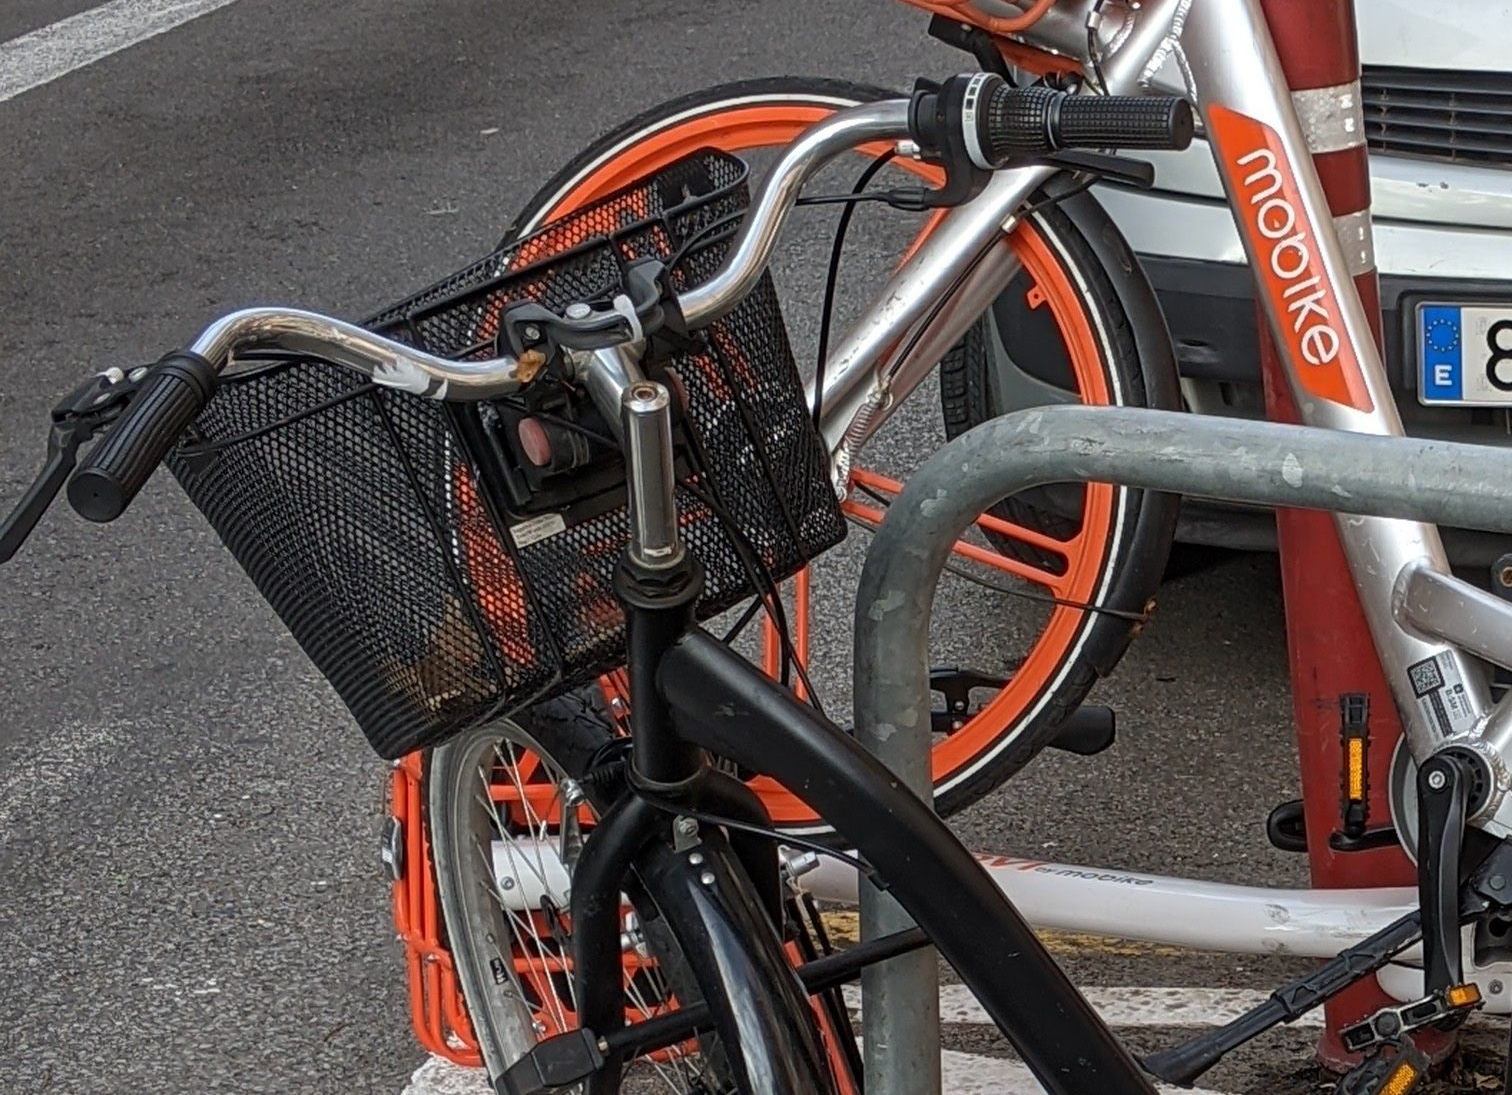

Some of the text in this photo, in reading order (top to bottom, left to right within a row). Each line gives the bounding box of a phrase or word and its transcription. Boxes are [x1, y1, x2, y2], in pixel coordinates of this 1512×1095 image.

[1236, 148, 1340, 366] mobike
[1434, 365, 1452, 386] E
[1055, 868, 1154, 886] mobike
